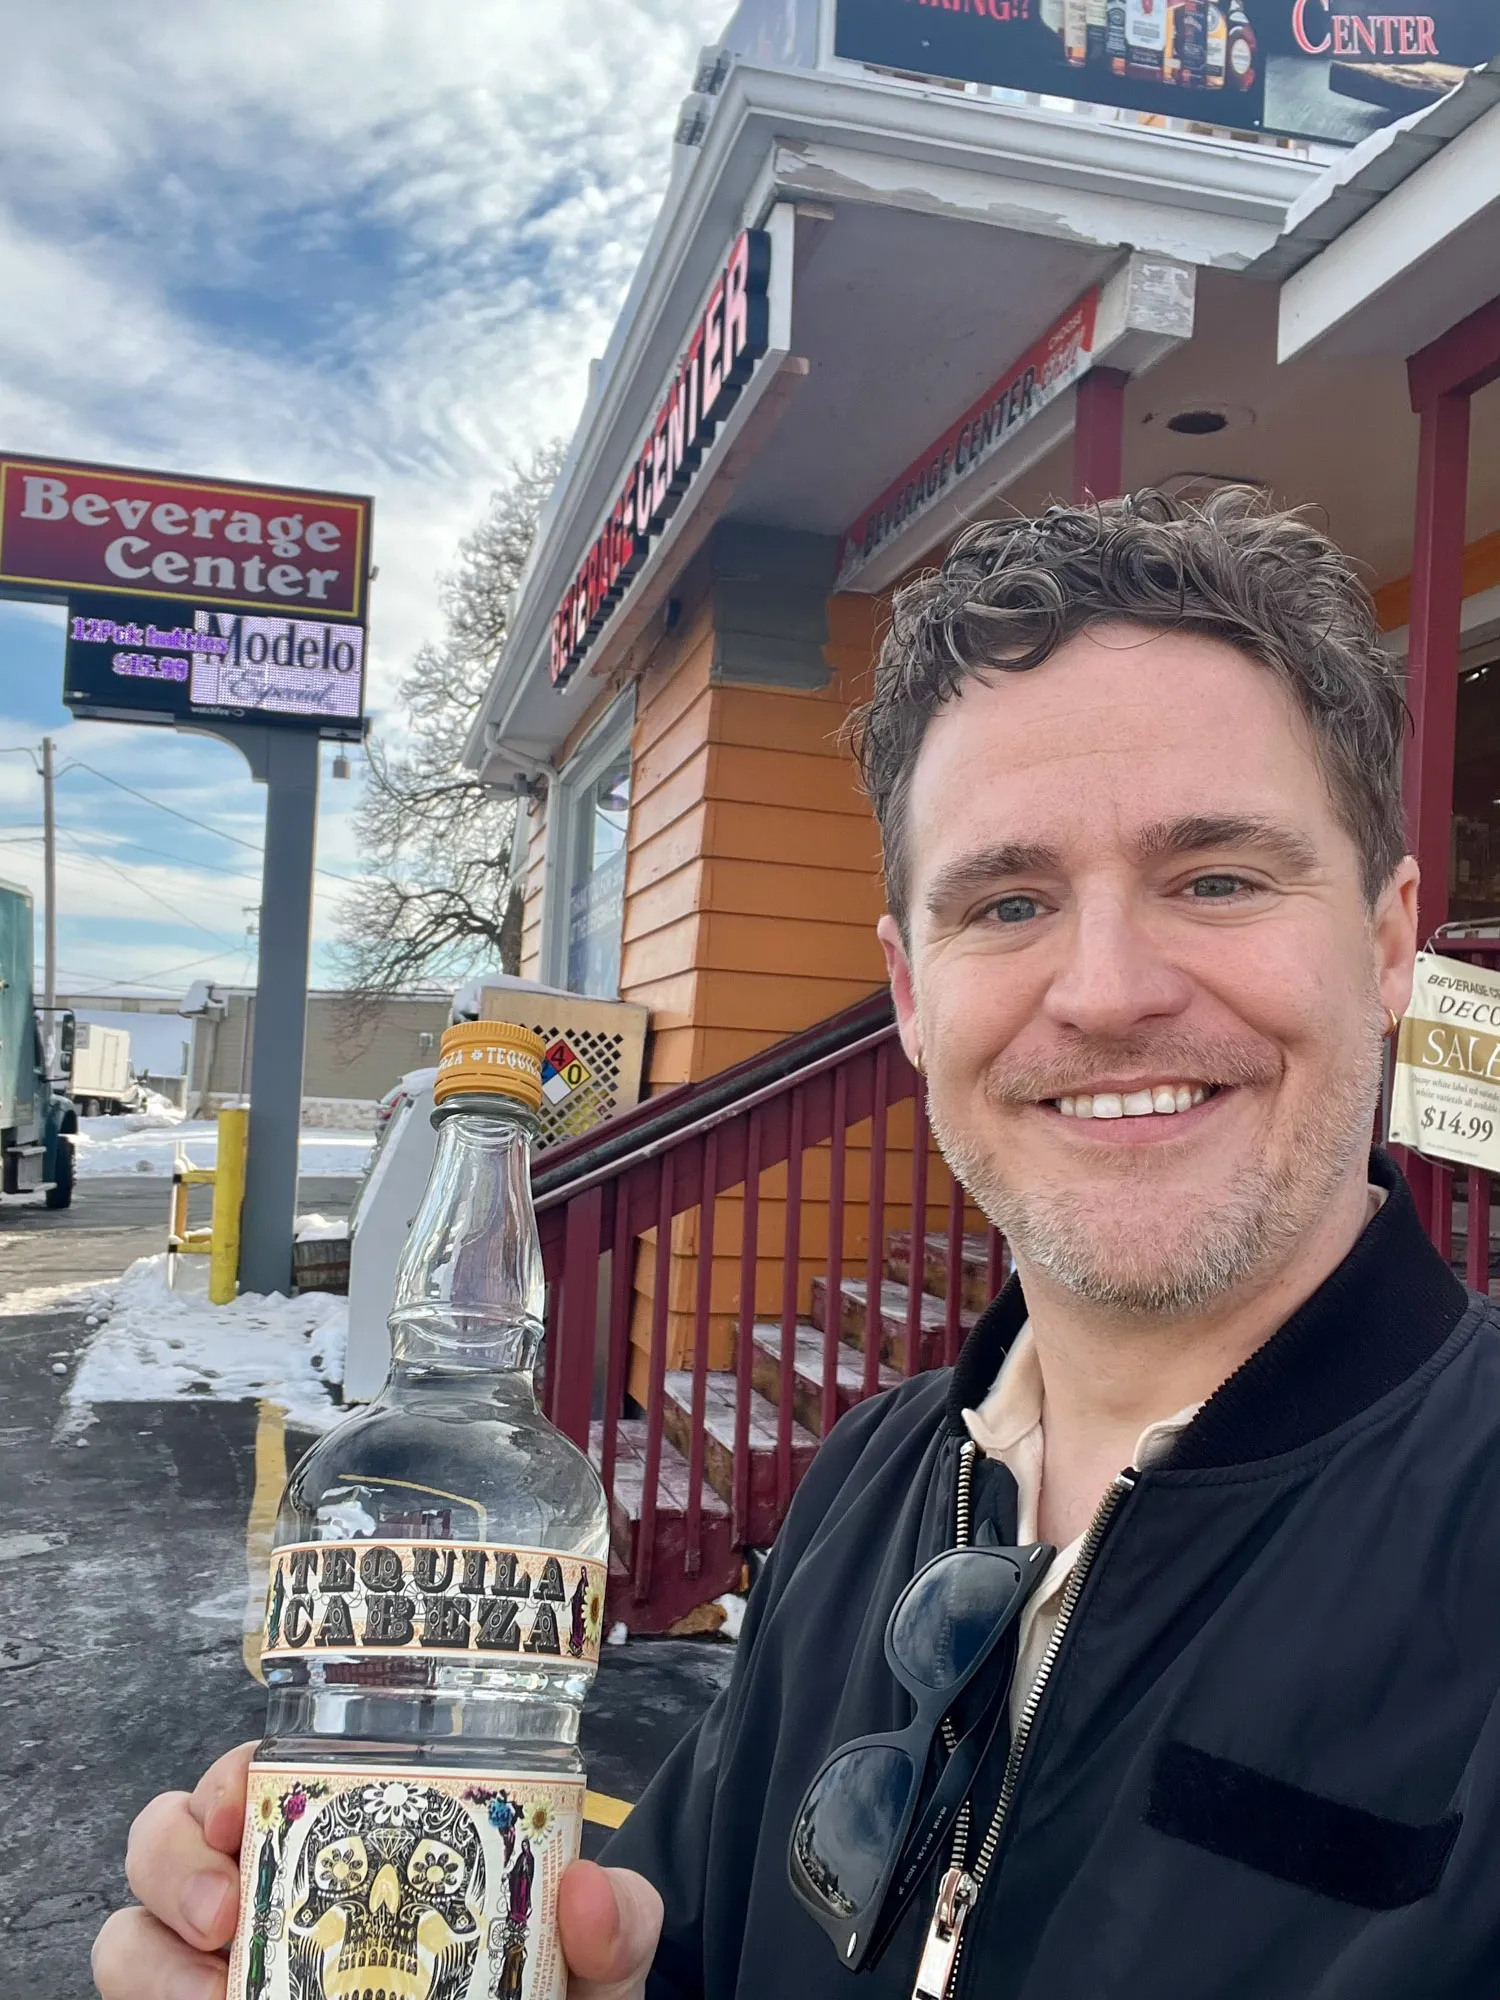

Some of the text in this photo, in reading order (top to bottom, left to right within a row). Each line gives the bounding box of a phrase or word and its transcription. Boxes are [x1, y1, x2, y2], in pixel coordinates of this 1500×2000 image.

[1292, 0, 1439, 55] CENTER
[635, 228, 752, 537] CENTER
[20, 475, 341, 558] Beverage
[104, 535, 339, 599] Center
[203, 612, 355, 674] Modelo
[1427, 974, 1489, 997] BEVERAGE
[551, 1045, 566, 1067] 4
[567, 1063, 582, 1085] 0
[1421, 1105, 1494, 1143] $14.99
[289, 1546, 566, 1602] TEQUILA
[283, 1593, 562, 1655] CABEZA
